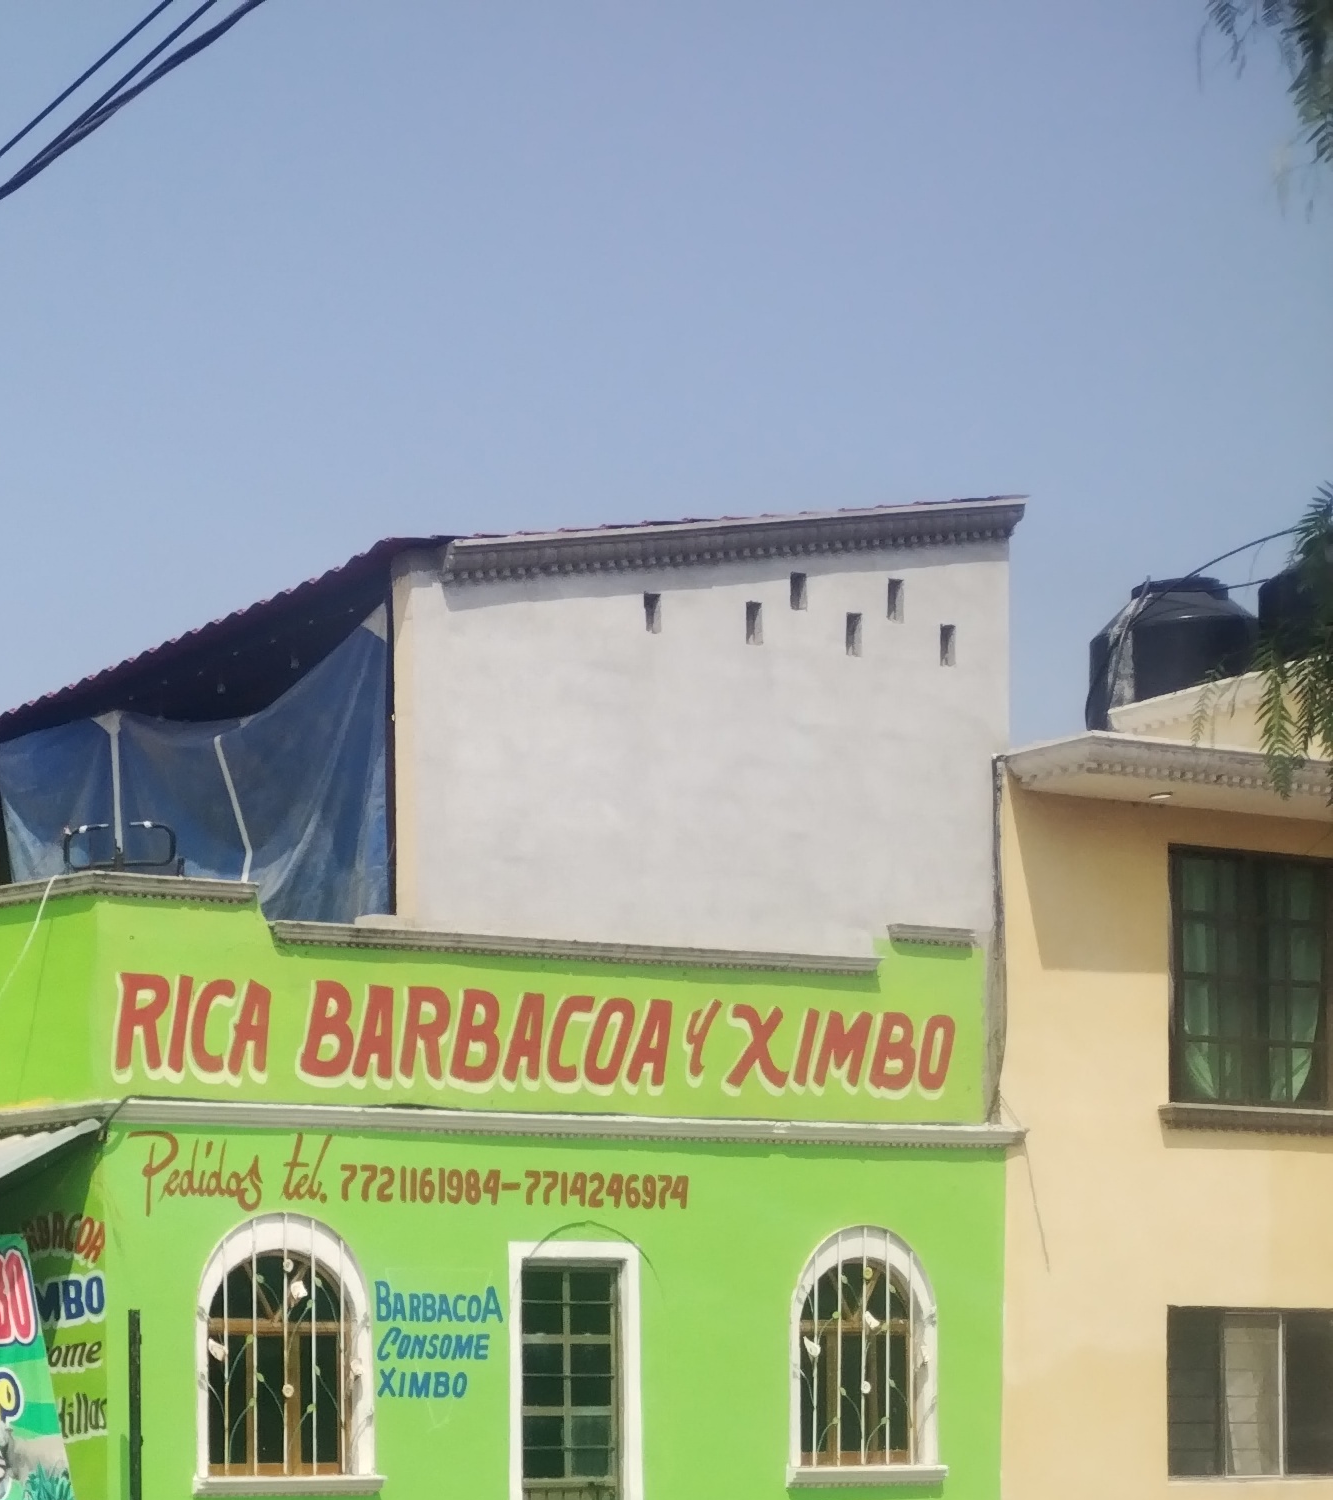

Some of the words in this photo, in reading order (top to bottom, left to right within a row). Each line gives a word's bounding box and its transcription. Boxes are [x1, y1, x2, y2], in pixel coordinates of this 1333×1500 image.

[113, 972, 272, 1081] RICA
[297, 979, 674, 1088] BARBACOA
[725, 1003, 956, 1091] XIMBO
[127, 1130, 264, 1218] Pedidos
[279, 1131, 333, 1205] tel.
[374, 1280, 504, 1324] BARBACOA
[377, 1366, 468, 1398] XIMBO
